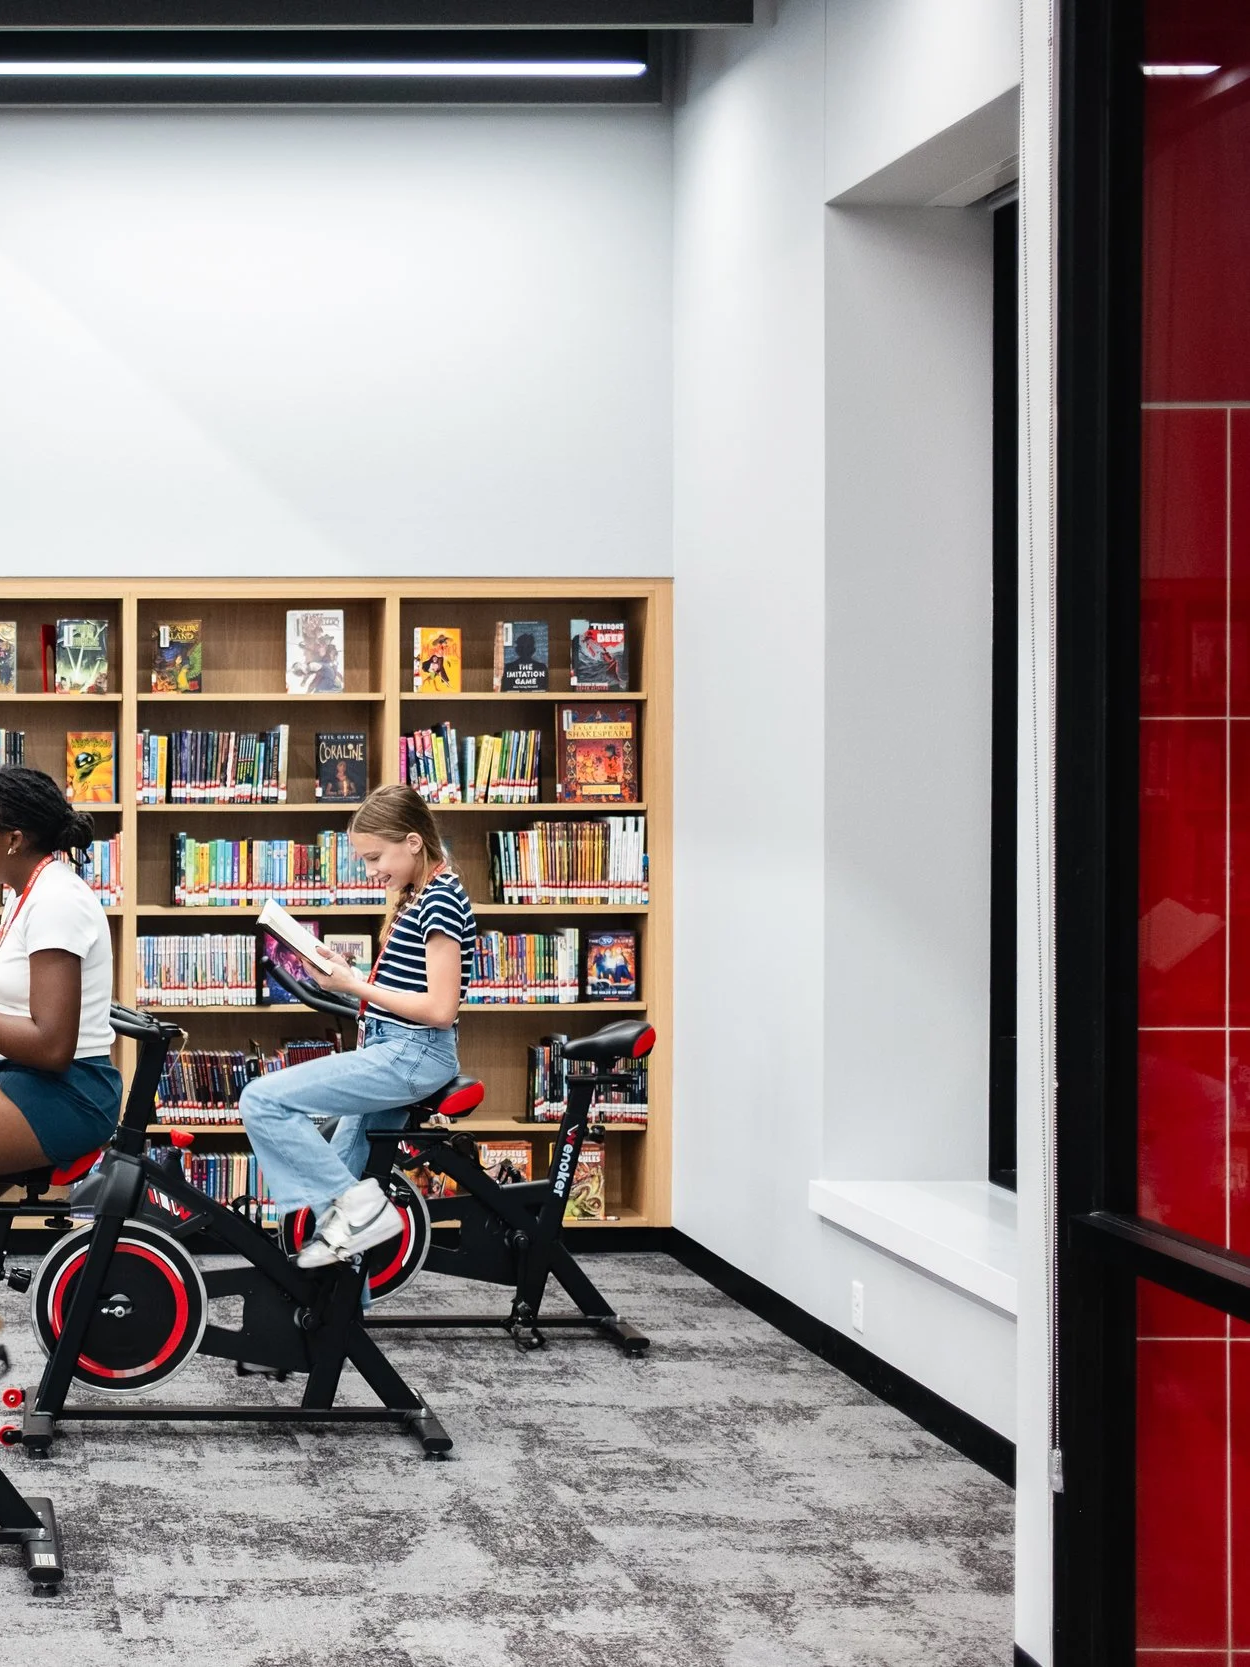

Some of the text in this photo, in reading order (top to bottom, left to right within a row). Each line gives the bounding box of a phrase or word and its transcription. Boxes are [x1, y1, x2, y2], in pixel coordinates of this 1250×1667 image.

[590, 623, 624, 631] TERRORS
[596, 633, 624, 643] DEEP
[518, 663, 533, 671] THE
[600, 936, 612, 945] 39
